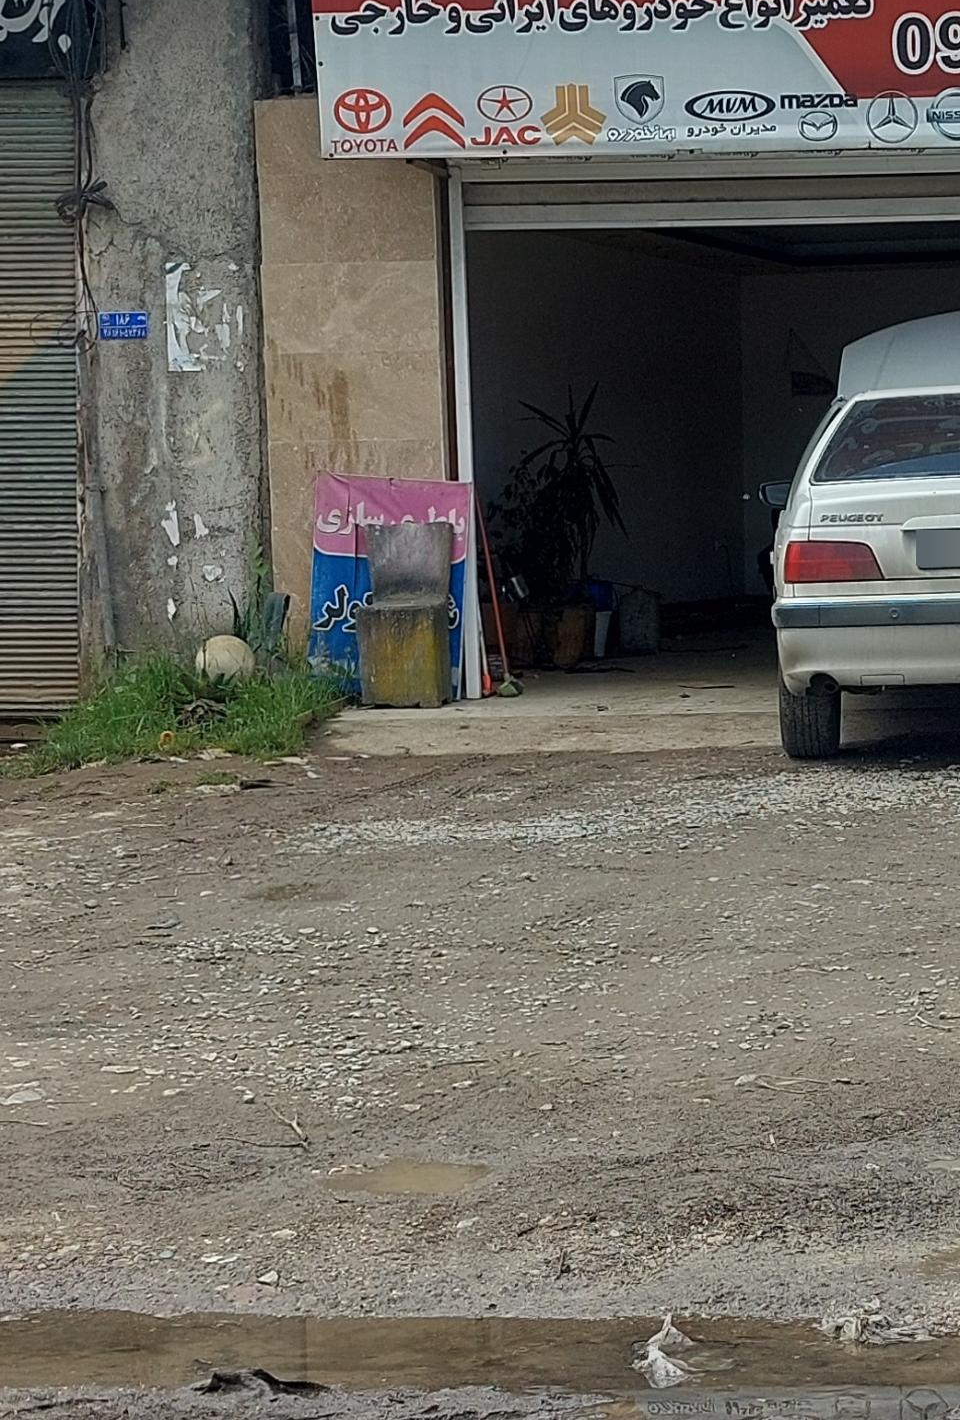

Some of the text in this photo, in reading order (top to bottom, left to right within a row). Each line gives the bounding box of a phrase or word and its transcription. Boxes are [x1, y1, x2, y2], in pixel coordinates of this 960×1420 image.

[701, 94, 758, 114] MVM
[470, 125, 543, 146] JAC
[686, 122, 777, 138] مدیران خودرو
[331, 138, 398, 154] TOYOTA
[820, 513, 884, 523] PEUGEOT
